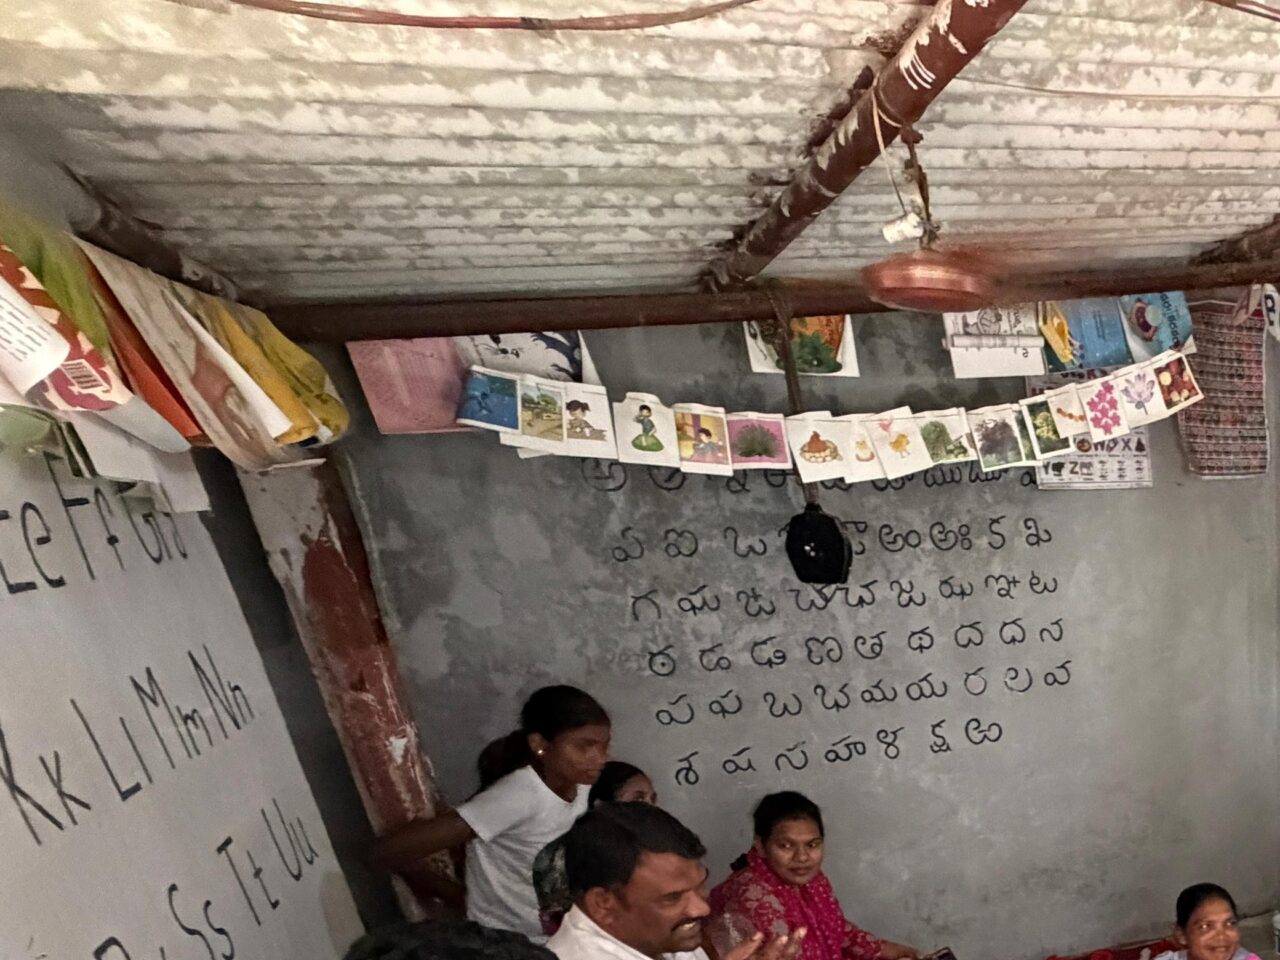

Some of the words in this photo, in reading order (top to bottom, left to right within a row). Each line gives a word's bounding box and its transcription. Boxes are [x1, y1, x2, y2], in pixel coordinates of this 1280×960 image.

[612, 527, 644, 562] ఏ
[664, 529, 698, 557] ఐ
[724, 526, 767, 558] ఒ
[988, 516, 1006, 550] క
[1024, 518, 1052, 547] ఖ
[632, 589, 661, 621] గ
[678, 585, 720, 614] ఘ
[890, 580, 926, 608] జ
[1029, 571, 1058, 594] ట
[699, 643, 732, 672] డ
[750, 636, 787, 668] ఢ
[805, 637, 843, 665] ణ
[854, 631, 887, 660] త
[908, 626, 934, 654] థ
[954, 621, 984, 648] ద
[999, 618, 1026, 645] ధ
[1039, 618, 1063, 642] న
[656, 694, 694, 725] ప
[763, 692, 802, 718] బ
[814, 683, 851, 712] భ
[861, 679, 897, 703] మ
[906, 673, 948, 701] య
[964, 667, 987, 696] ర
[1004, 667, 1033, 692] ల
[1044, 660, 1072, 686] వ
[675, 751, 699, 785] శ
[722, 747, 756, 774] ష
[775, 743, 808, 771] స
[824, 736, 866, 763] హ
[876, 727, 904, 759] ళ
